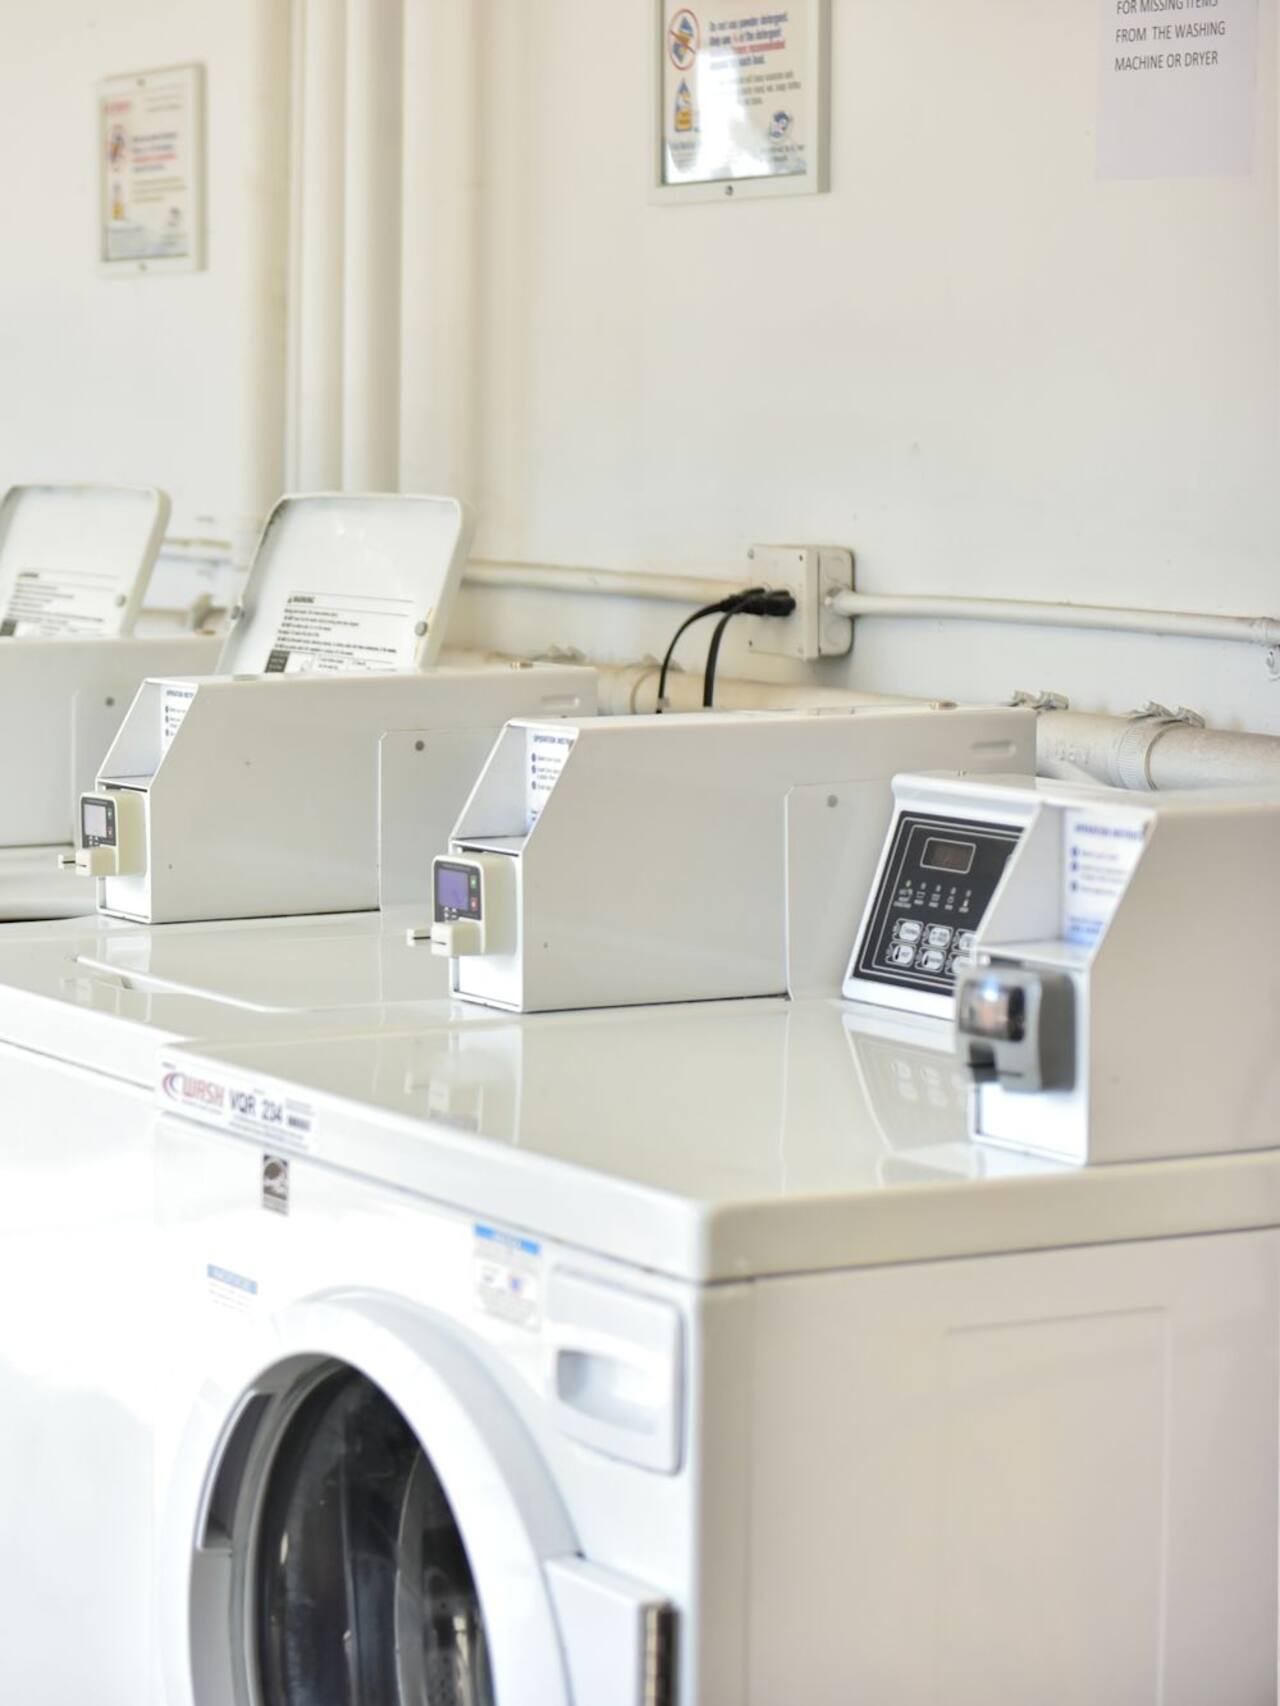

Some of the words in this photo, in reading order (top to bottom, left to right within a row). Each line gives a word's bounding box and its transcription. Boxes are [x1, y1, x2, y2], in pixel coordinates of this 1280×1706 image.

[1116, 0, 1137, 14] FOR
[1140, 0, 1184, 13] MISSING
[1116, 28, 1147, 42] FROM
[1152, 25, 1172, 39] THE
[1175, 21, 1226, 38] WASHING
[1115, 54, 1164, 71] MACHINE
[1166, 53, 1182, 68] OR
[1184, 51, 1218, 67] DRYER
[182, 1077, 225, 1107] WASH
[229, 1089, 257, 1117] VQR
